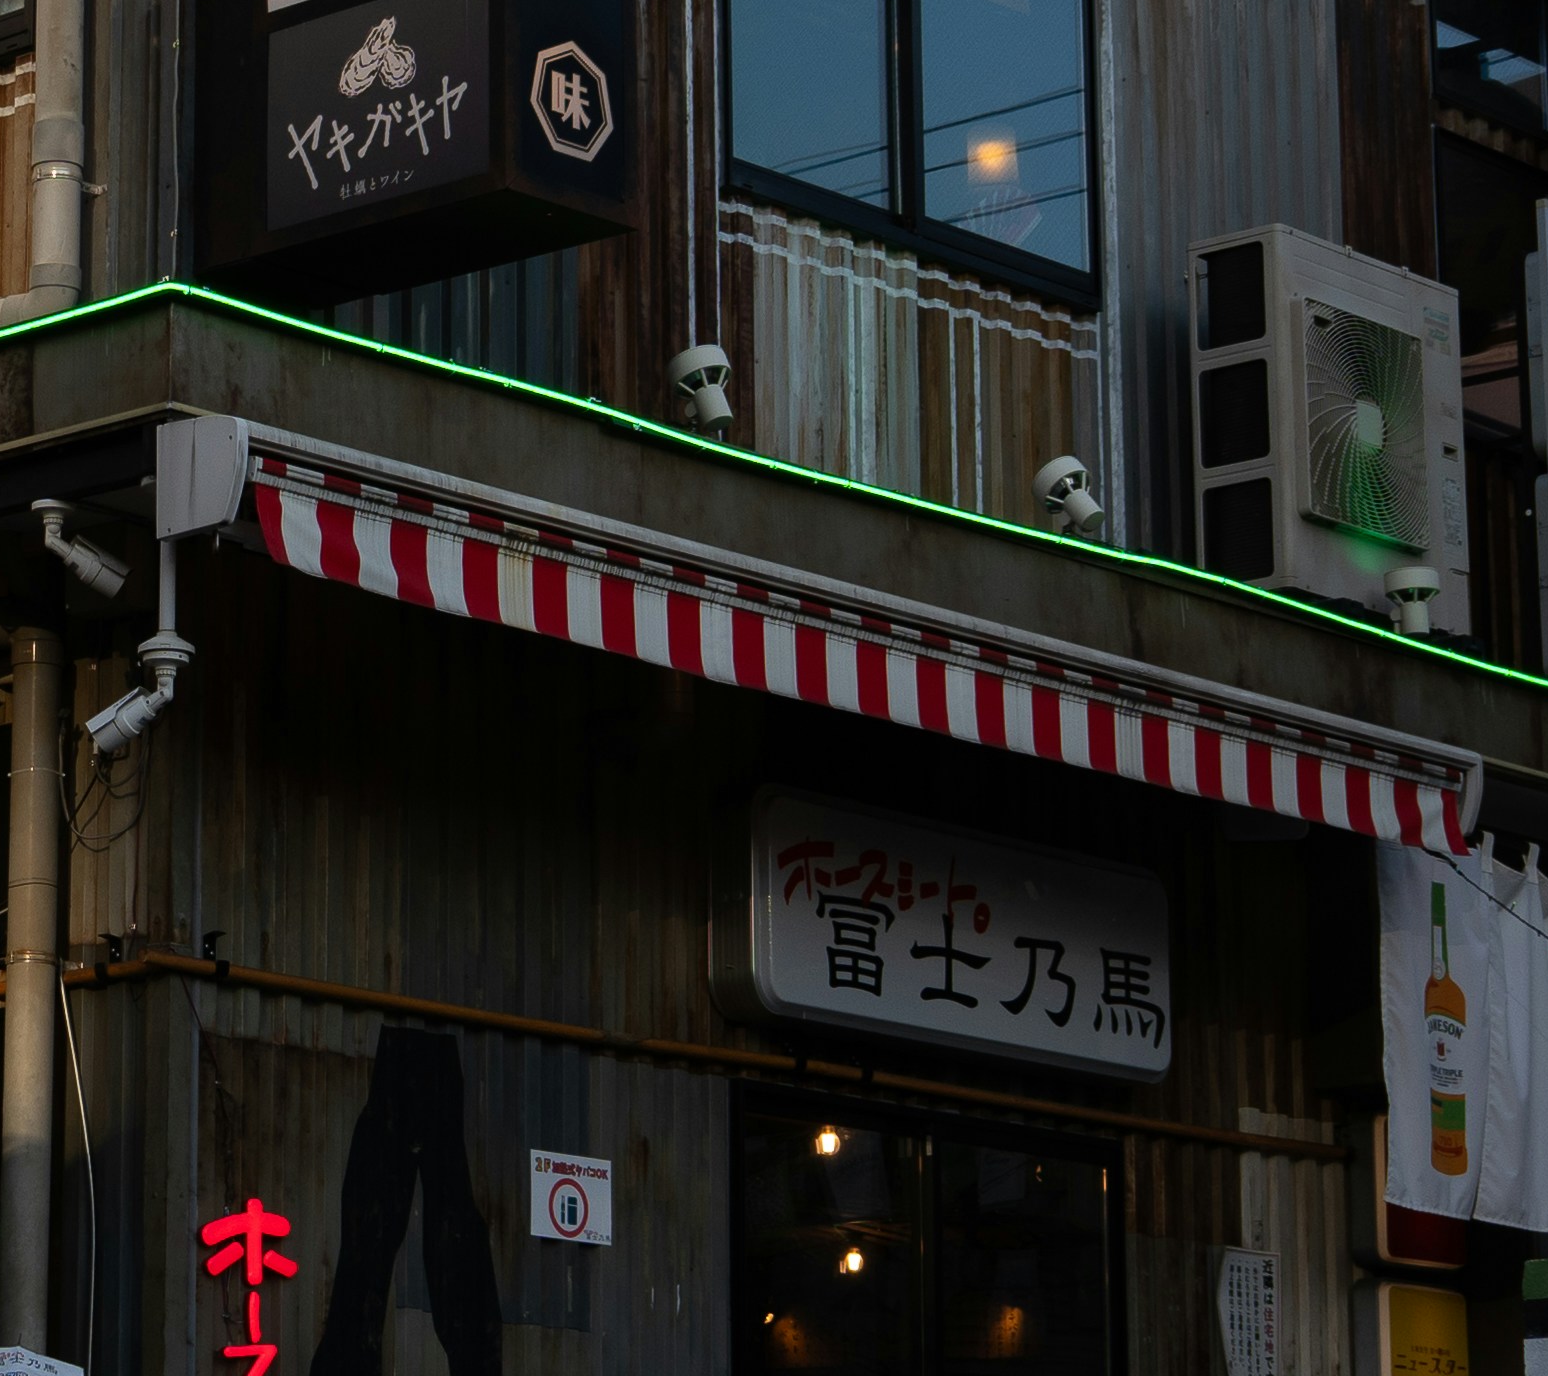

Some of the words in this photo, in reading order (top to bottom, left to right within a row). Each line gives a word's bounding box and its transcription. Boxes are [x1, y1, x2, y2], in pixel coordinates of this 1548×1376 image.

[550, 70, 592, 131] 味
[816, 890, 1166, 1050] 富士乃馬
[1394, 1354, 1466, 1375] ニュースター
